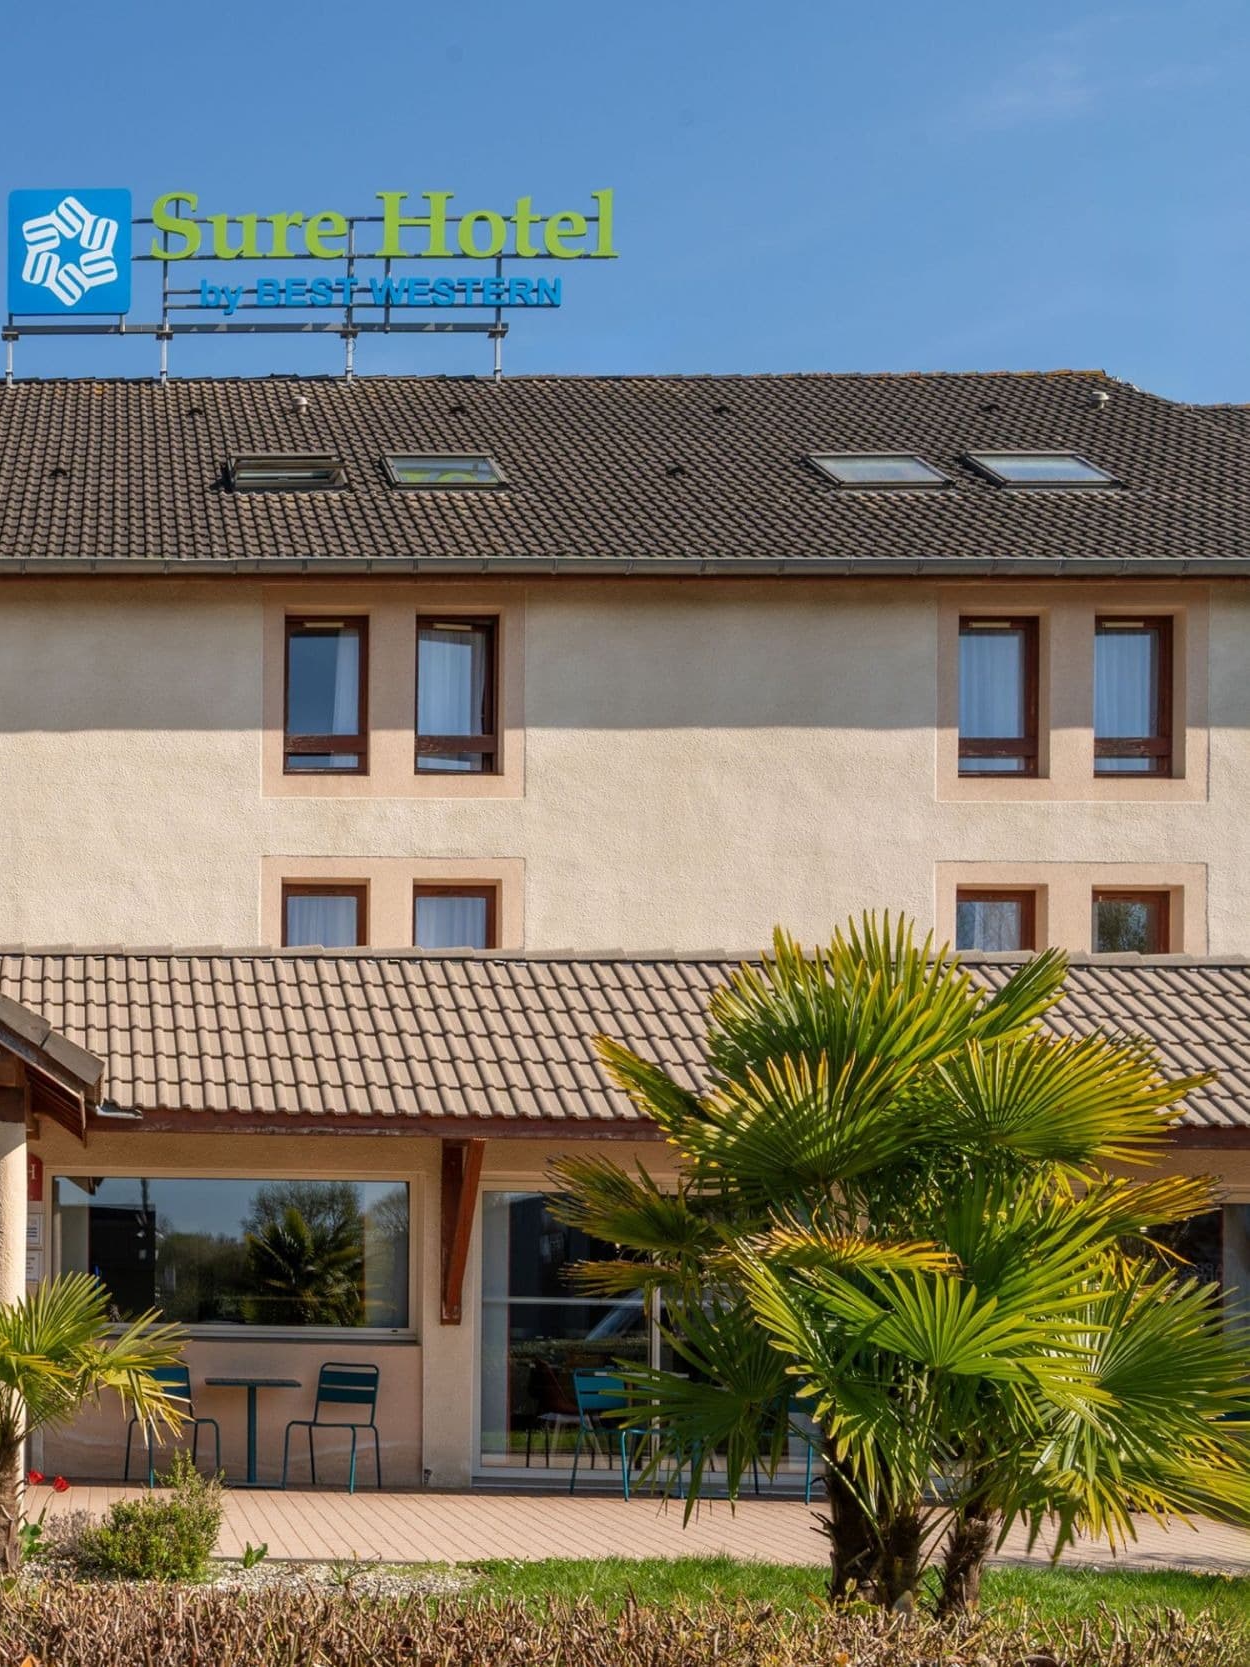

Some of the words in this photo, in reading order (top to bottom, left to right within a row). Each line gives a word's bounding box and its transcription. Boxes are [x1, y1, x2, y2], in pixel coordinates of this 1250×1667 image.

[151, 191, 348, 260] Sure
[375, 188, 620, 260] Hotel
[201, 279, 244, 316] by
[256, 277, 359, 308] BEST
[369, 277, 562, 308] WESTERN
